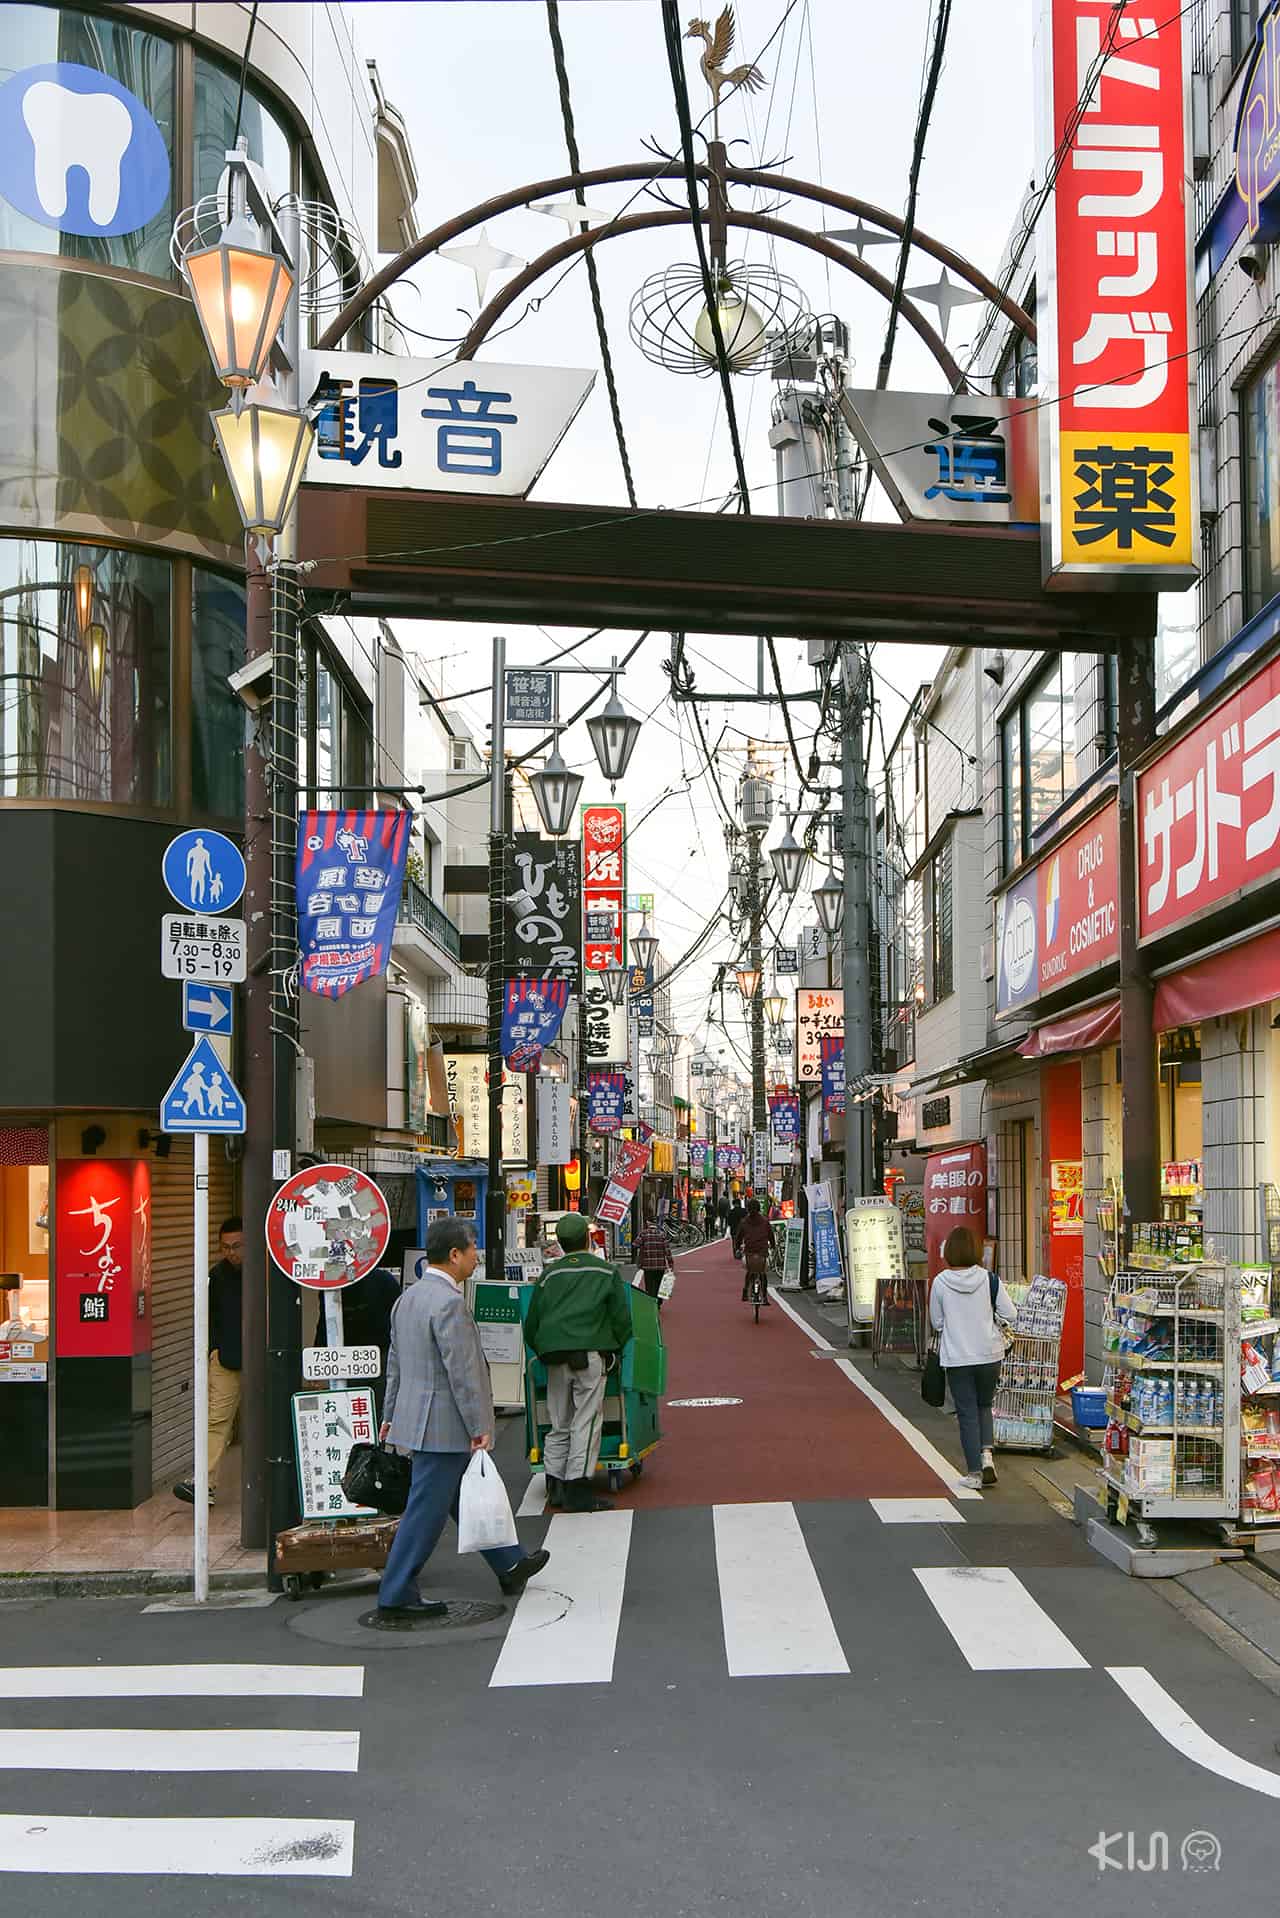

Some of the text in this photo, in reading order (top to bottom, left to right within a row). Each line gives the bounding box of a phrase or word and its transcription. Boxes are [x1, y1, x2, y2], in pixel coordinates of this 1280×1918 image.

[310, 370, 519, 478] 観音
[1072, 446, 1177, 549] 薬
[512, 676, 548, 694] 笹塚
[509, 695, 550, 708] 観音通り
[515, 707, 545, 718] 商店街
[1078, 834, 1104, 880] DRUG
[1088, 878, 1095, 908] &
[170, 921, 240, 942] 自転車を除く
[1069, 901, 1116, 956] COSMETIC
[591, 950, 613, 964] 2F
[1041, 951, 1067, 983] SUNDRUG
[587, 986, 611, 1058] もつ焼き
[930, 1169, 984, 1190] 洋服の
[929, 1195, 983, 1216] お直し
[852, 1215, 895, 1227] マッサージ
[83, 1297, 105, 1319] 鮨
[352, 1350, 377, 1361] 8:30
[323, 1400, 343, 1510] お買物道路
